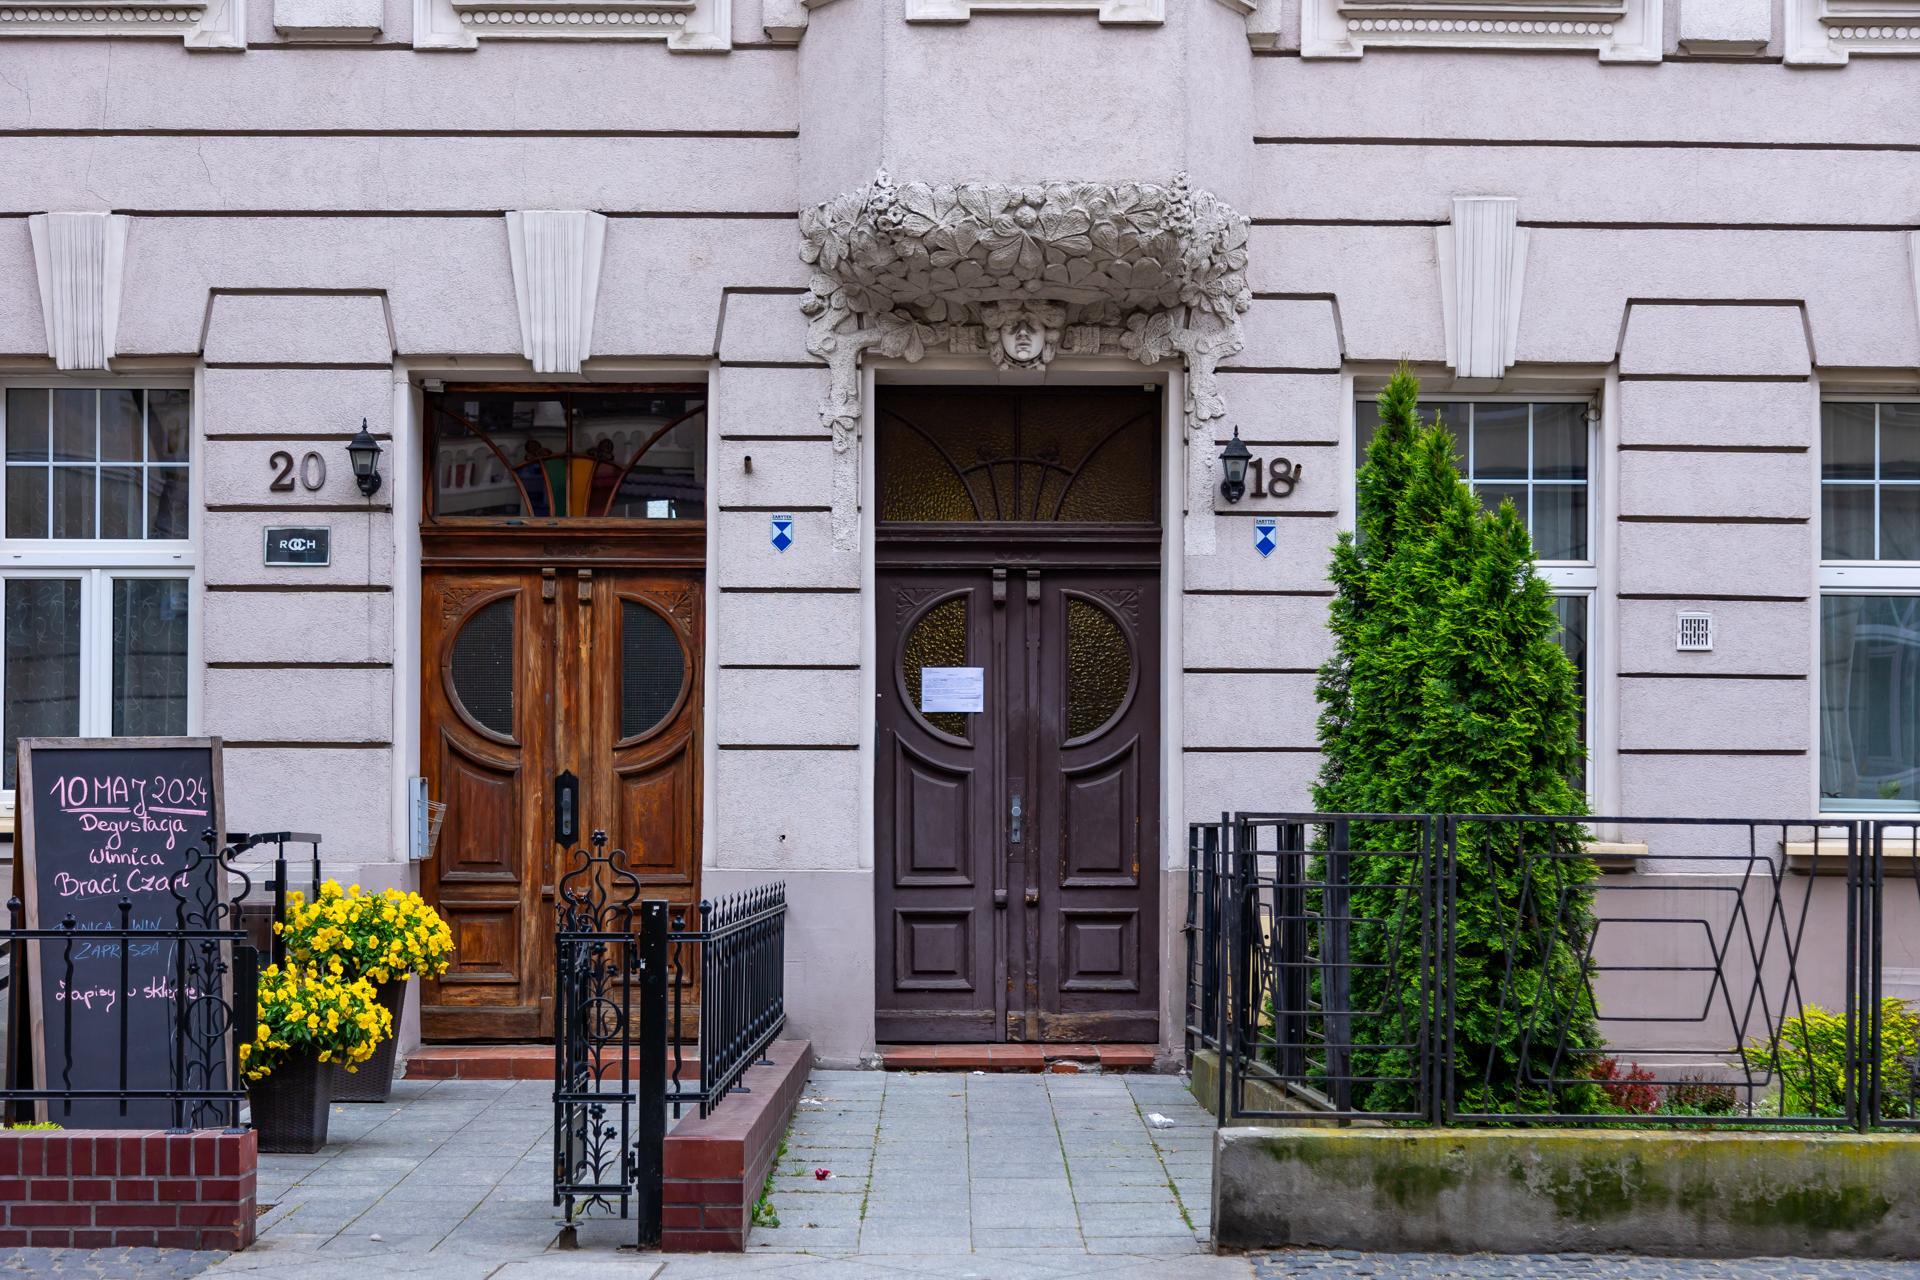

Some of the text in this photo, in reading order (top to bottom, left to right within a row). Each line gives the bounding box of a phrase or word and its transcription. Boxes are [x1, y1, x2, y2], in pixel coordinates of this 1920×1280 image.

[269, 450, 326, 492] 20
[1249, 457, 1294, 498] 18
[279, 538, 316, 551] ROCH
[50, 776, 208, 816] 10 MAJ 2024
[79, 811, 187, 850] Degustacja
[54, 872, 121, 897] Braci
[74, 941, 161, 960] ZAPRSZA
